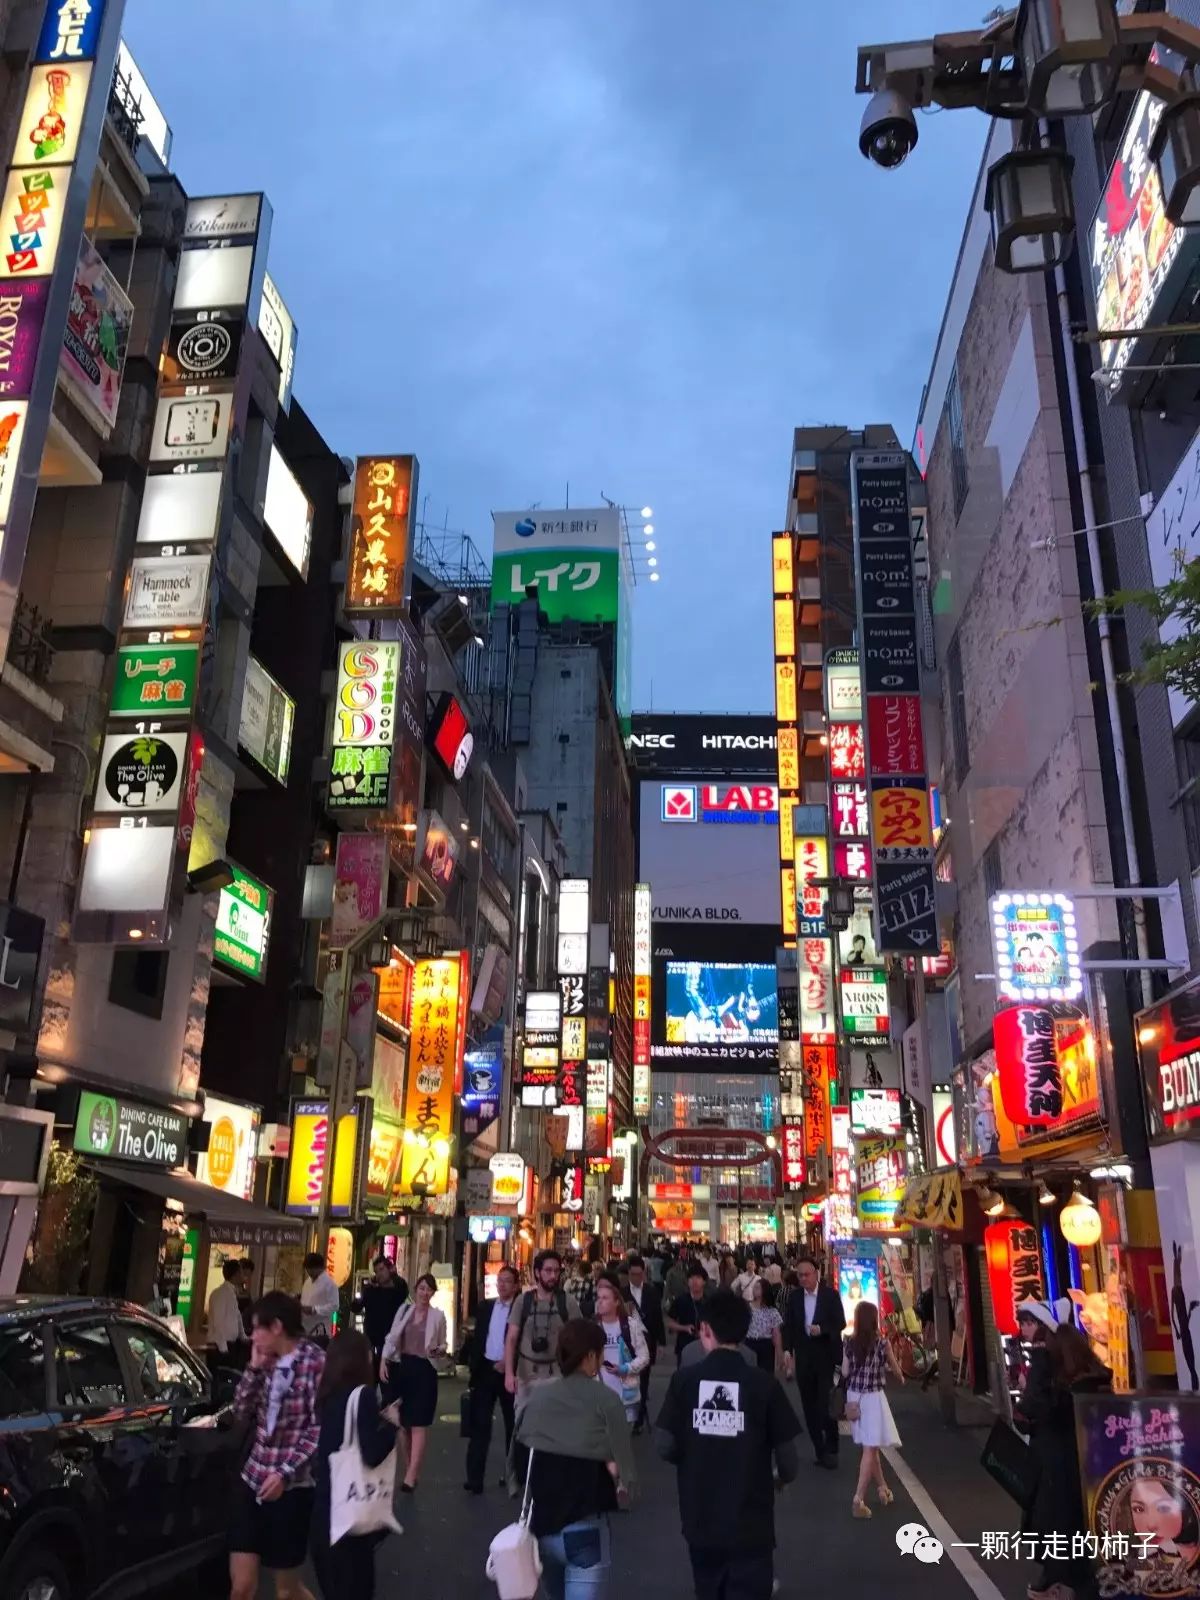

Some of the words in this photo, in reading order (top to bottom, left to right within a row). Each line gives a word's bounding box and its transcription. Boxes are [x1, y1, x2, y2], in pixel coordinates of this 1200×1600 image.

[172, 463, 199, 474] 4F
[862, 479, 880, 488] Party
[541, 520, 599, 534] 新生銀行
[161, 545, 187, 556] 3F
[866, 552, 884, 561] Party
[142, 577, 192, 592] Hammock
[511, 561, 602, 593] レイク
[151, 593, 181, 603] Table
[147, 632, 175, 643] 2F
[869, 628, 887, 637] Party
[125, 657, 176, 678] リーチ
[140, 679, 187, 701] 麻雀
[135, 722, 162, 733] 1F
[629, 734, 676, 748] NEC
[701, 734, 778, 750] HITACHI
[331, 746, 392, 776] 麻雀
[117, 770, 135, 781] The
[136, 770, 165, 781] Olive
[355, 775, 388, 797] 4F
[878, 789, 923, 846] らーめん
[880, 878, 902, 894] Party
[901, 866, 928, 884] Space
[650, 906, 703, 920] YUNIKA
[705, 907, 742, 921] BLDG.
[881, 885, 932, 930] RIZ
[844, 991, 886, 1003] XROSS
[849, 1003, 881, 1015] CASA
[650, 1045, 780, 1059] 組放映中のユニカビジョンに
[120, 1107, 146, 1124] DINING
[147, 1110, 164, 1128] CAFE
[168, 1120, 181, 1132] BAR
[118, 1123, 142, 1157] The
[143, 1129, 178, 1163] Olive
[860, 1136, 897, 1160] キラリ
[1009, 1226, 1043, 1304] 博多天
[1144, 1408, 1180, 1433] Bar
